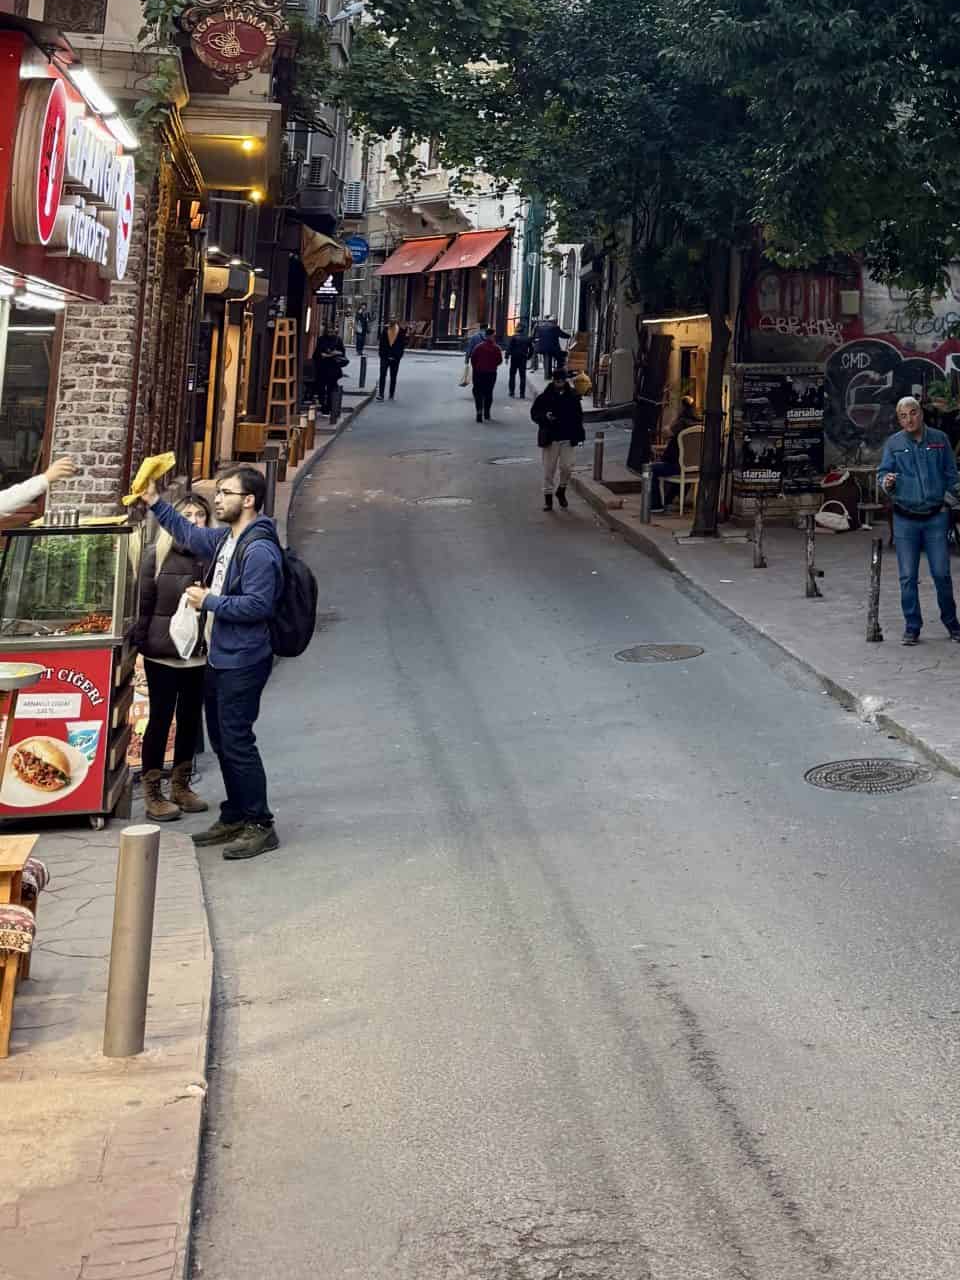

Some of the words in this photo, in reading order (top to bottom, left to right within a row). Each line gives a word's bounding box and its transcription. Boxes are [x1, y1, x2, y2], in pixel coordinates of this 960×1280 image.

[786, 407, 825, 418] starsailor
[742, 469, 782, 480] starsailor
[57, 668, 105, 708] CİĞERİ
